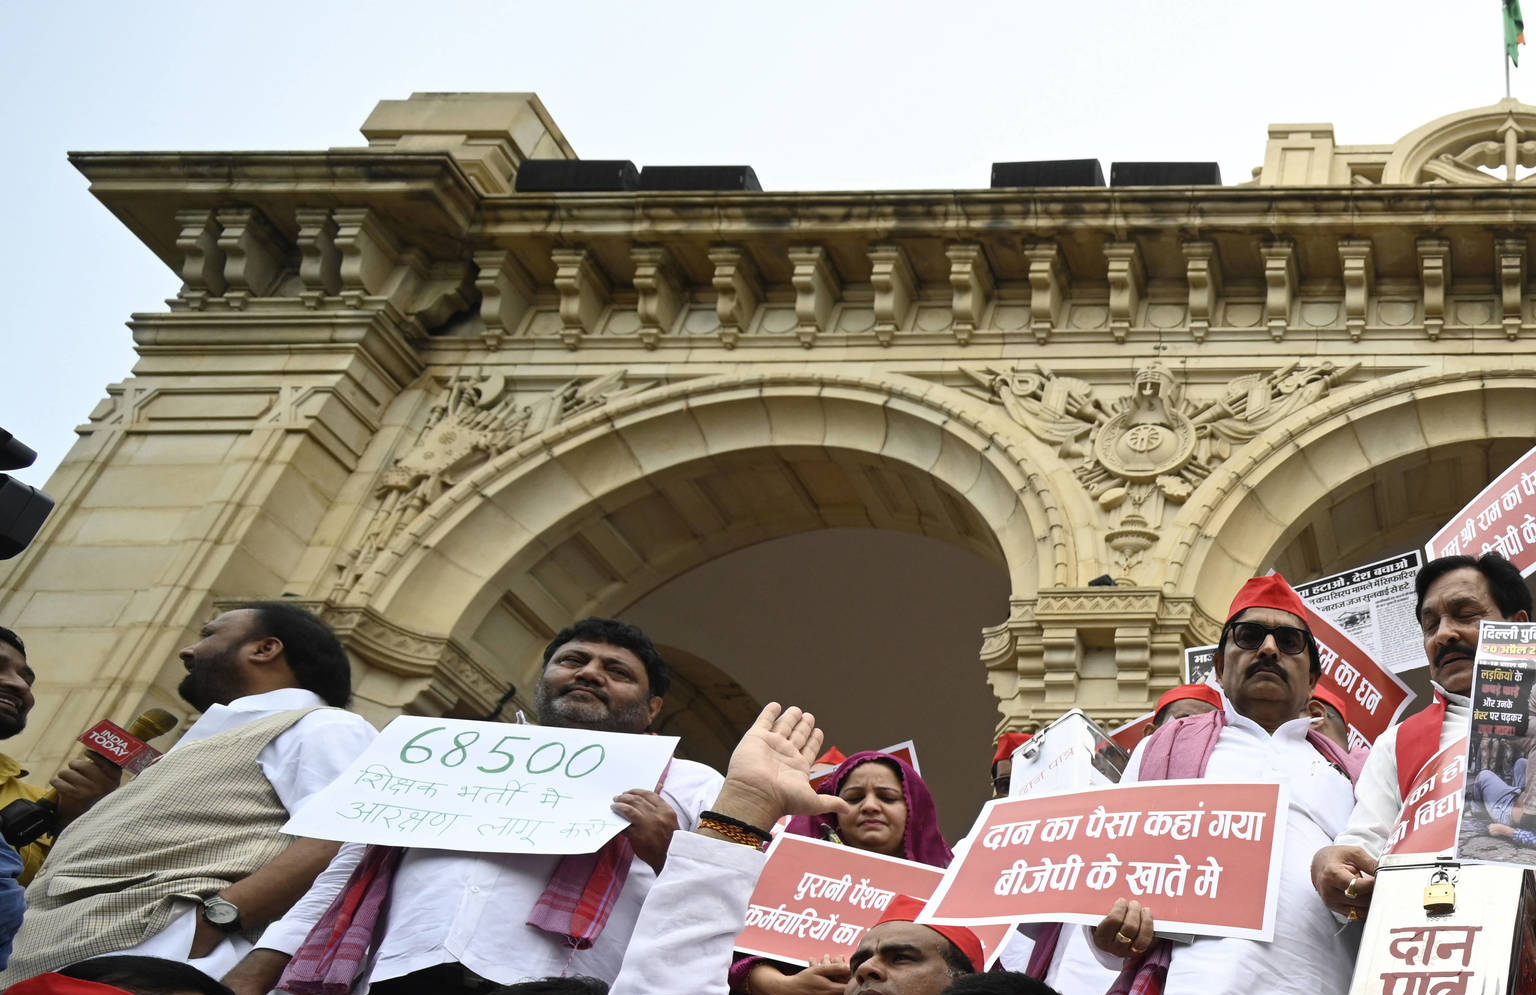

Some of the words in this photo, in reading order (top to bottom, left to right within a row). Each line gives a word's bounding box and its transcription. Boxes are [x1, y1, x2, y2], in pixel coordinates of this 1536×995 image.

[1460, 515, 1476, 548] श्री
[1477, 500, 1502, 531] राम
[1501, 485, 1523, 510] का
[1352, 572, 1371, 583] देश
[1374, 560, 1408, 577] बचाओ
[1482, 625, 1518, 641] दिल्ली
[1334, 658, 1360, 694] का
[1481, 668, 1514, 681] लड़कियों
[1514, 670, 1523, 681] के
[1483, 697, 1495, 707] और
[1496, 698, 1513, 708] उनके
[1490, 712, 1499, 720] पर
[89, 731, 129, 757] TODAY
[100, 730, 128, 749] INDIA
[400, 727, 605, 778] 68500
[354, 764, 448, 798] शिक्षक
[457, 779, 537, 806] भर्ती
[1409, 773, 1438, 806] का
[336, 802, 472, 836] आरक्षण
[983, 820, 1040, 850] दान
[1040, 815, 1083, 842] का
[1085, 805, 1142, 840] पैसा
[1143, 801, 1204, 841] कहां
[1208, 810, 1266, 841] गया
[794, 872, 851, 901] पुरानी
[849, 878, 895, 911] पेंशन
[993, 854, 1084, 896] बीजेपी
[1086, 853, 1122, 890] के
[1125, 854, 1190, 898] खाते
[744, 903, 840, 944] कर्मचारियों
[832, 921, 863, 946] का
[1389, 925, 1483, 967] दान
